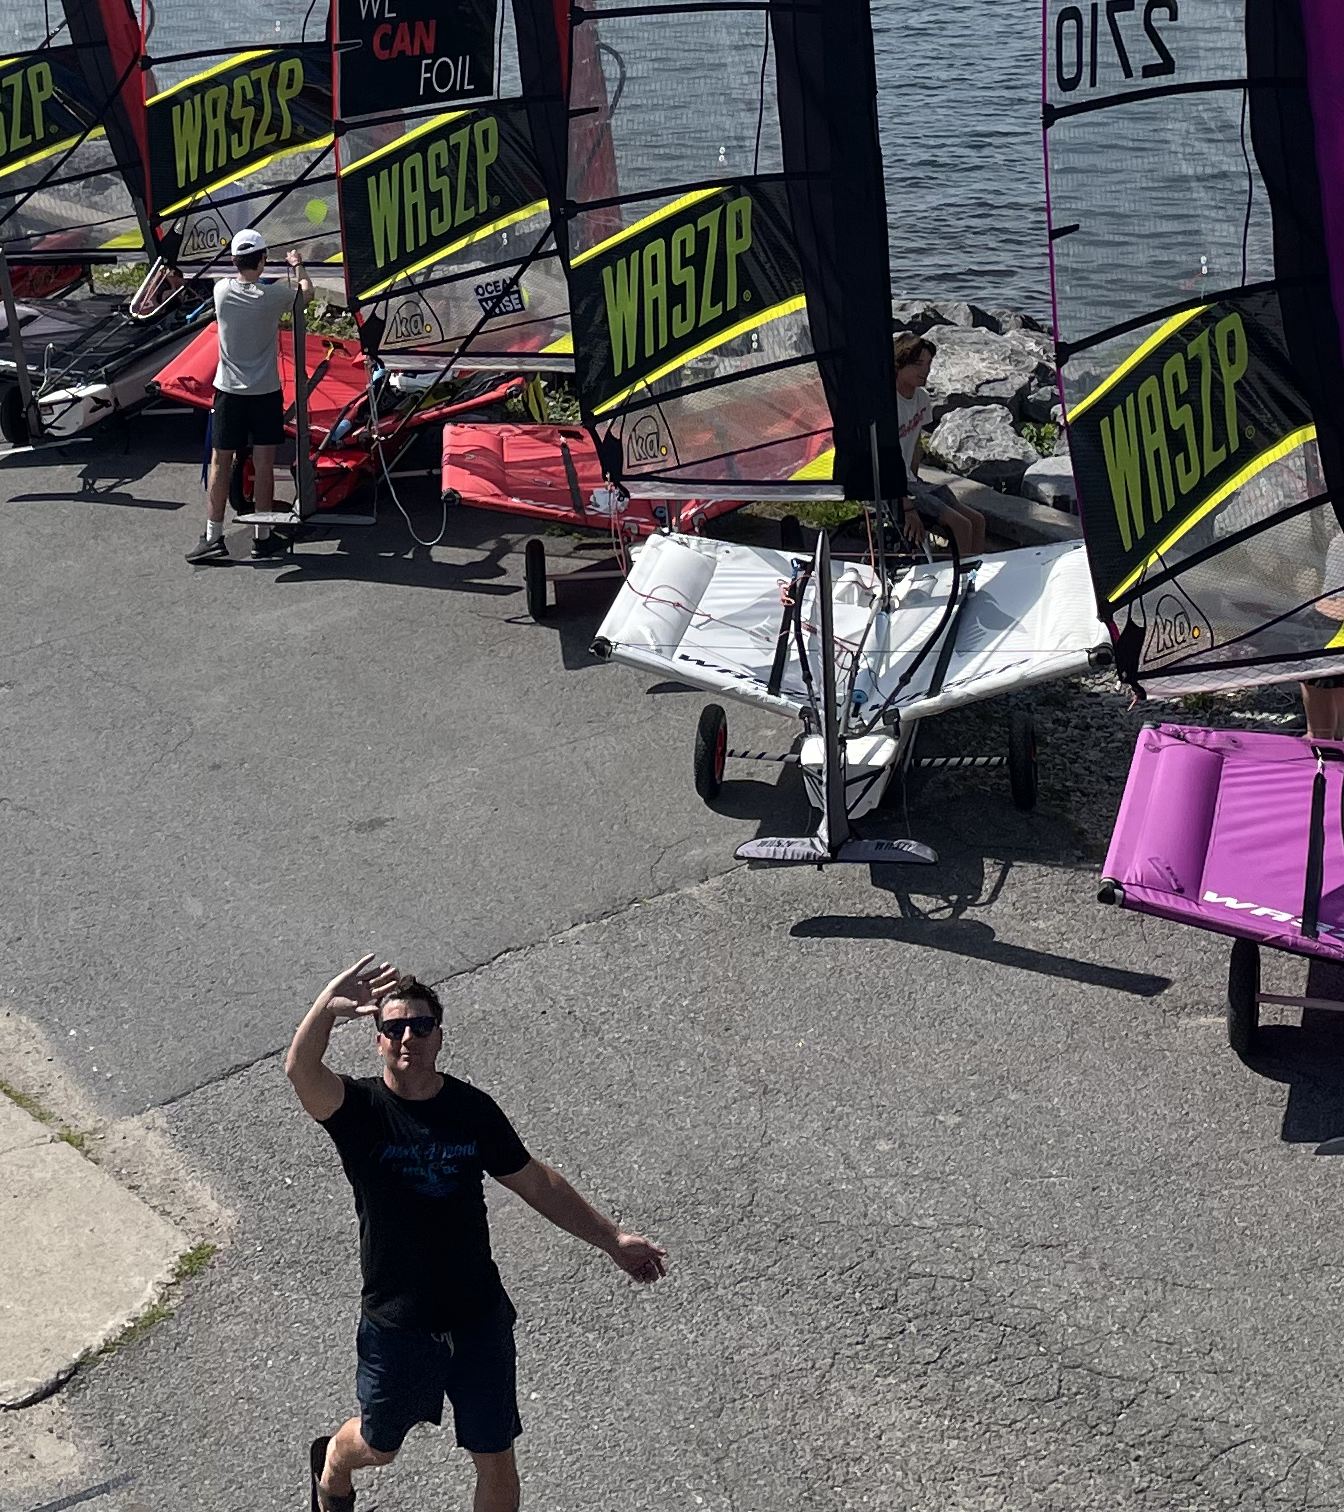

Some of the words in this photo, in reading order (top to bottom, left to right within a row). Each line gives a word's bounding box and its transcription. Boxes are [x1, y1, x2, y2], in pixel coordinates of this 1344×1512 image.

[372, 19, 437, 61] CAN
[419, 54, 475, 96] FOIL
[171, 57, 305, 189] WASZP
[367, 115, 500, 269] WASZP
[601, 195, 753, 379] WASZP
[1099, 311, 1256, 553] WASZP
